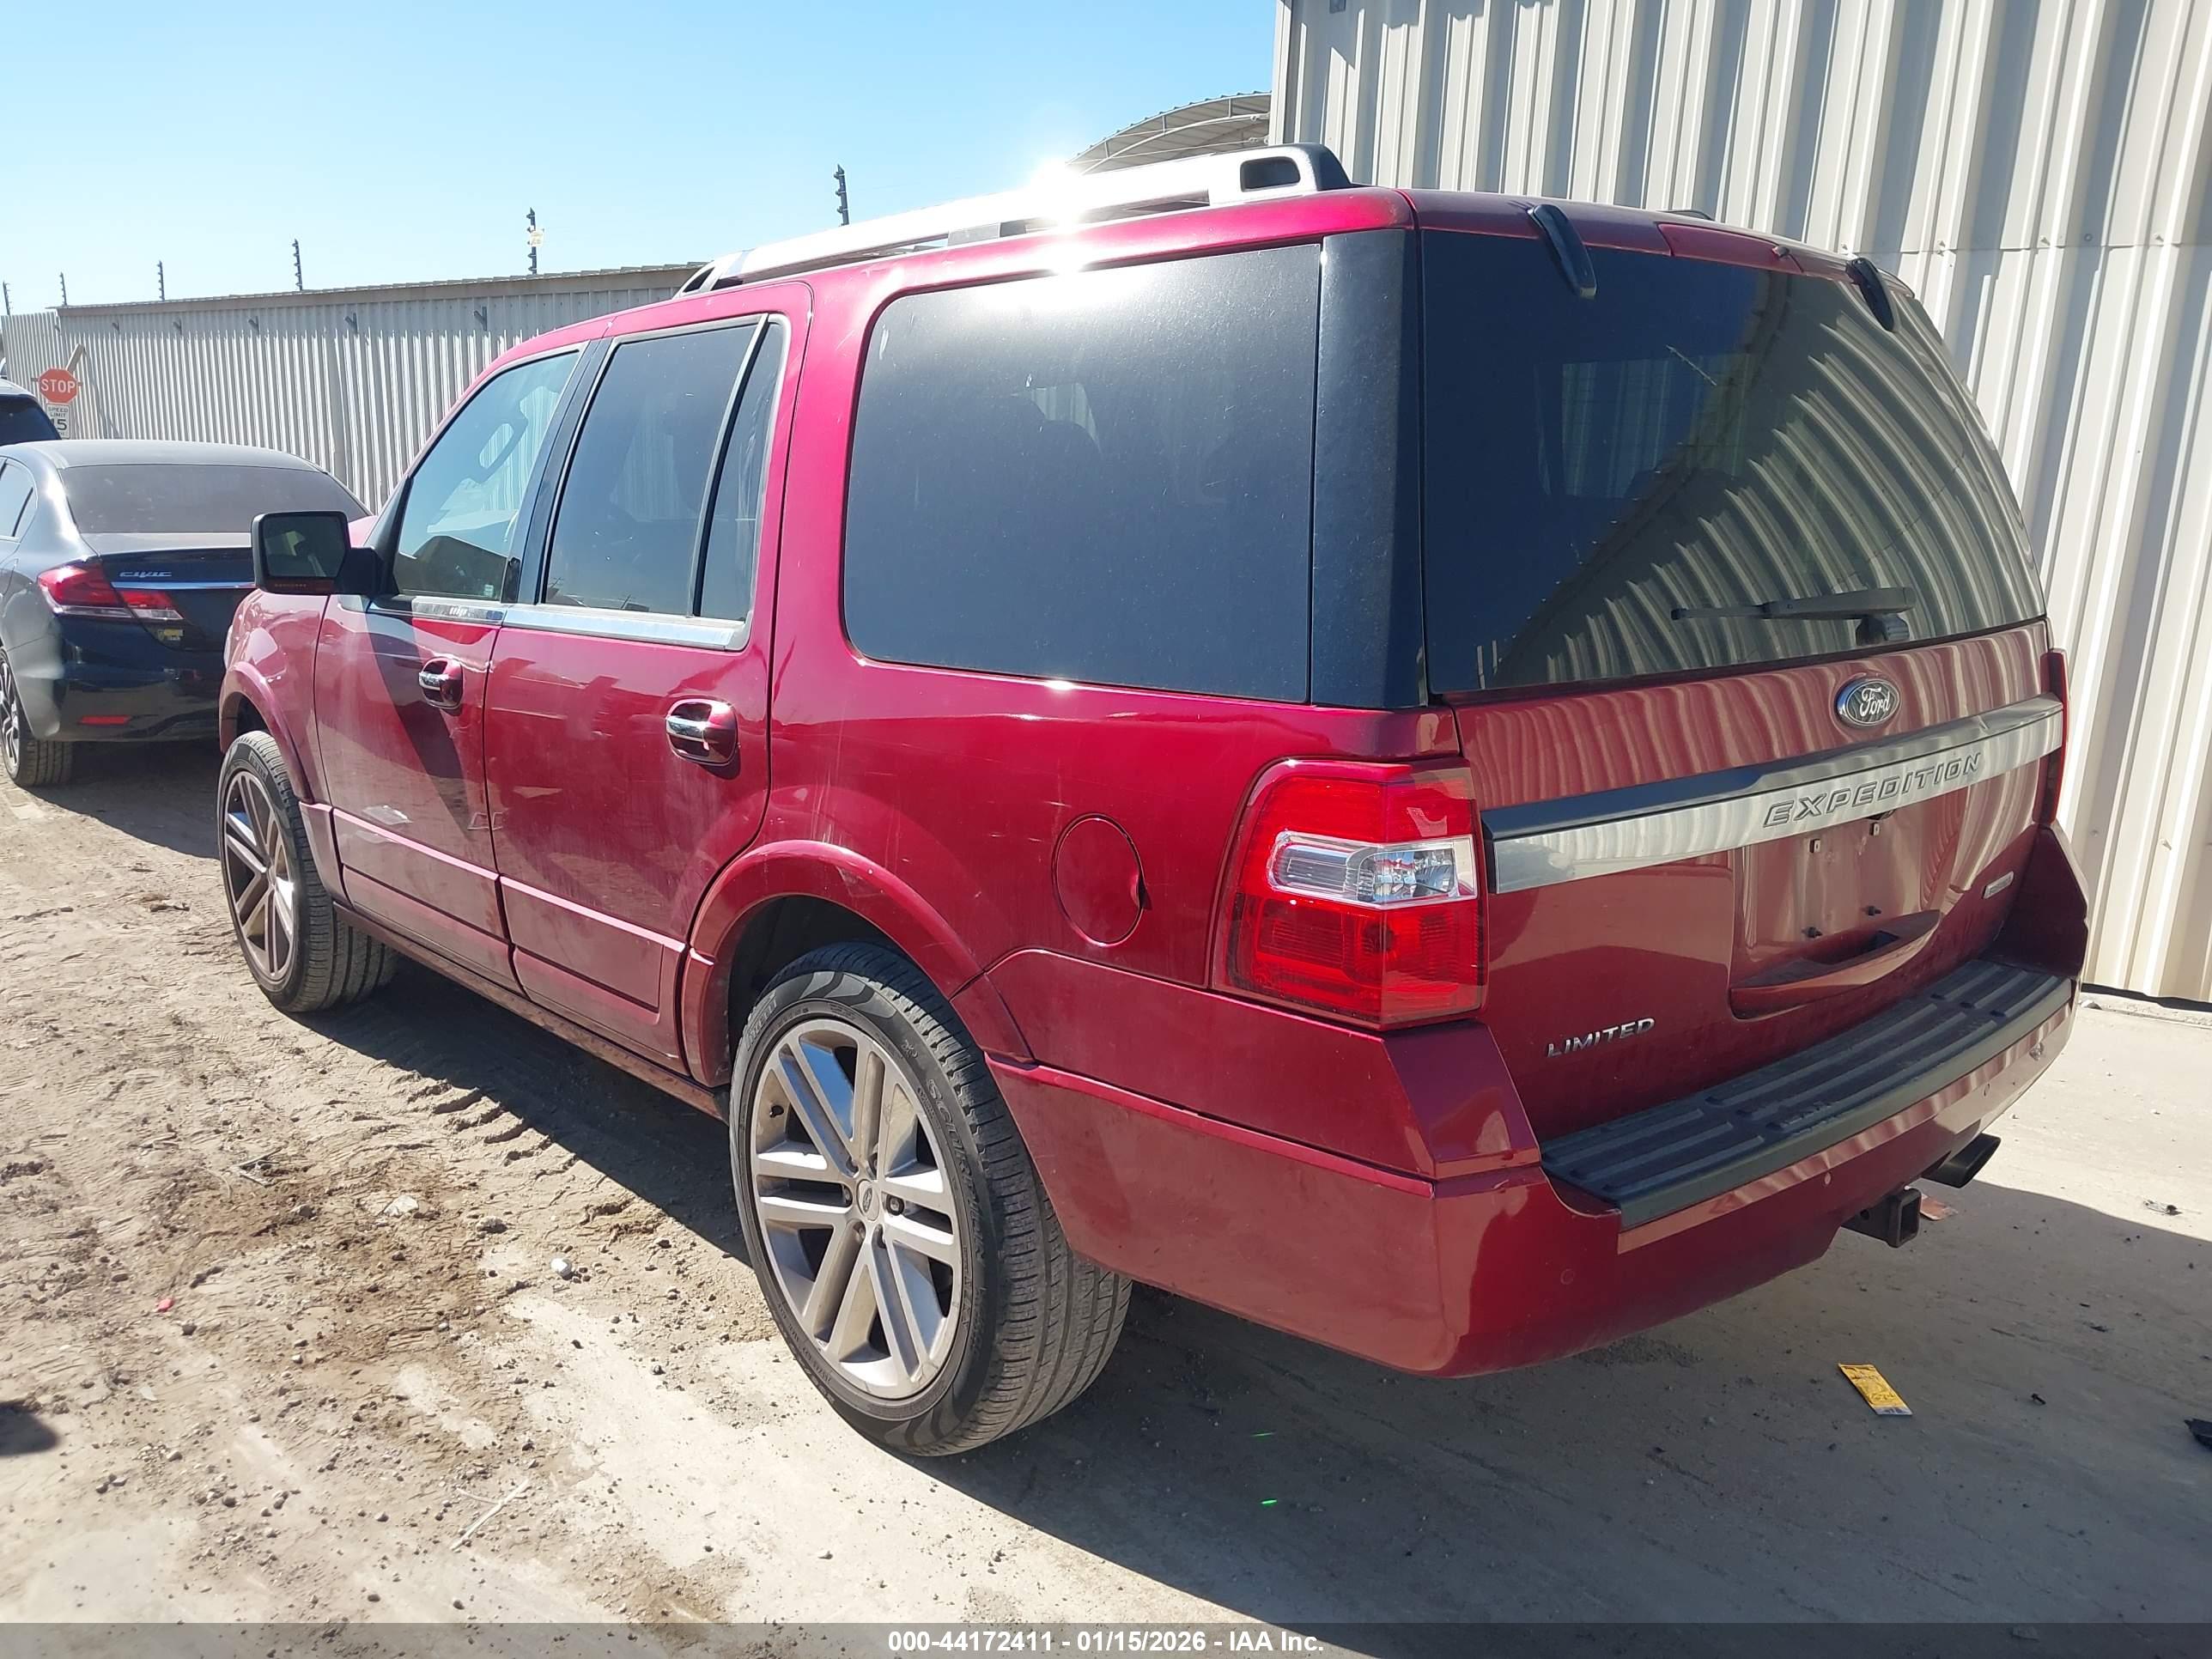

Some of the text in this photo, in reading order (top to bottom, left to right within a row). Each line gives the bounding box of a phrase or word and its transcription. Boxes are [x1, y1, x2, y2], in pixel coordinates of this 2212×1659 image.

[40, 379, 76, 393] STOP
[1859, 686, 1892, 717] Ford
[1762, 752, 1983, 828] EXPEDITION
[1546, 1017, 1656, 1059] LIMITED
